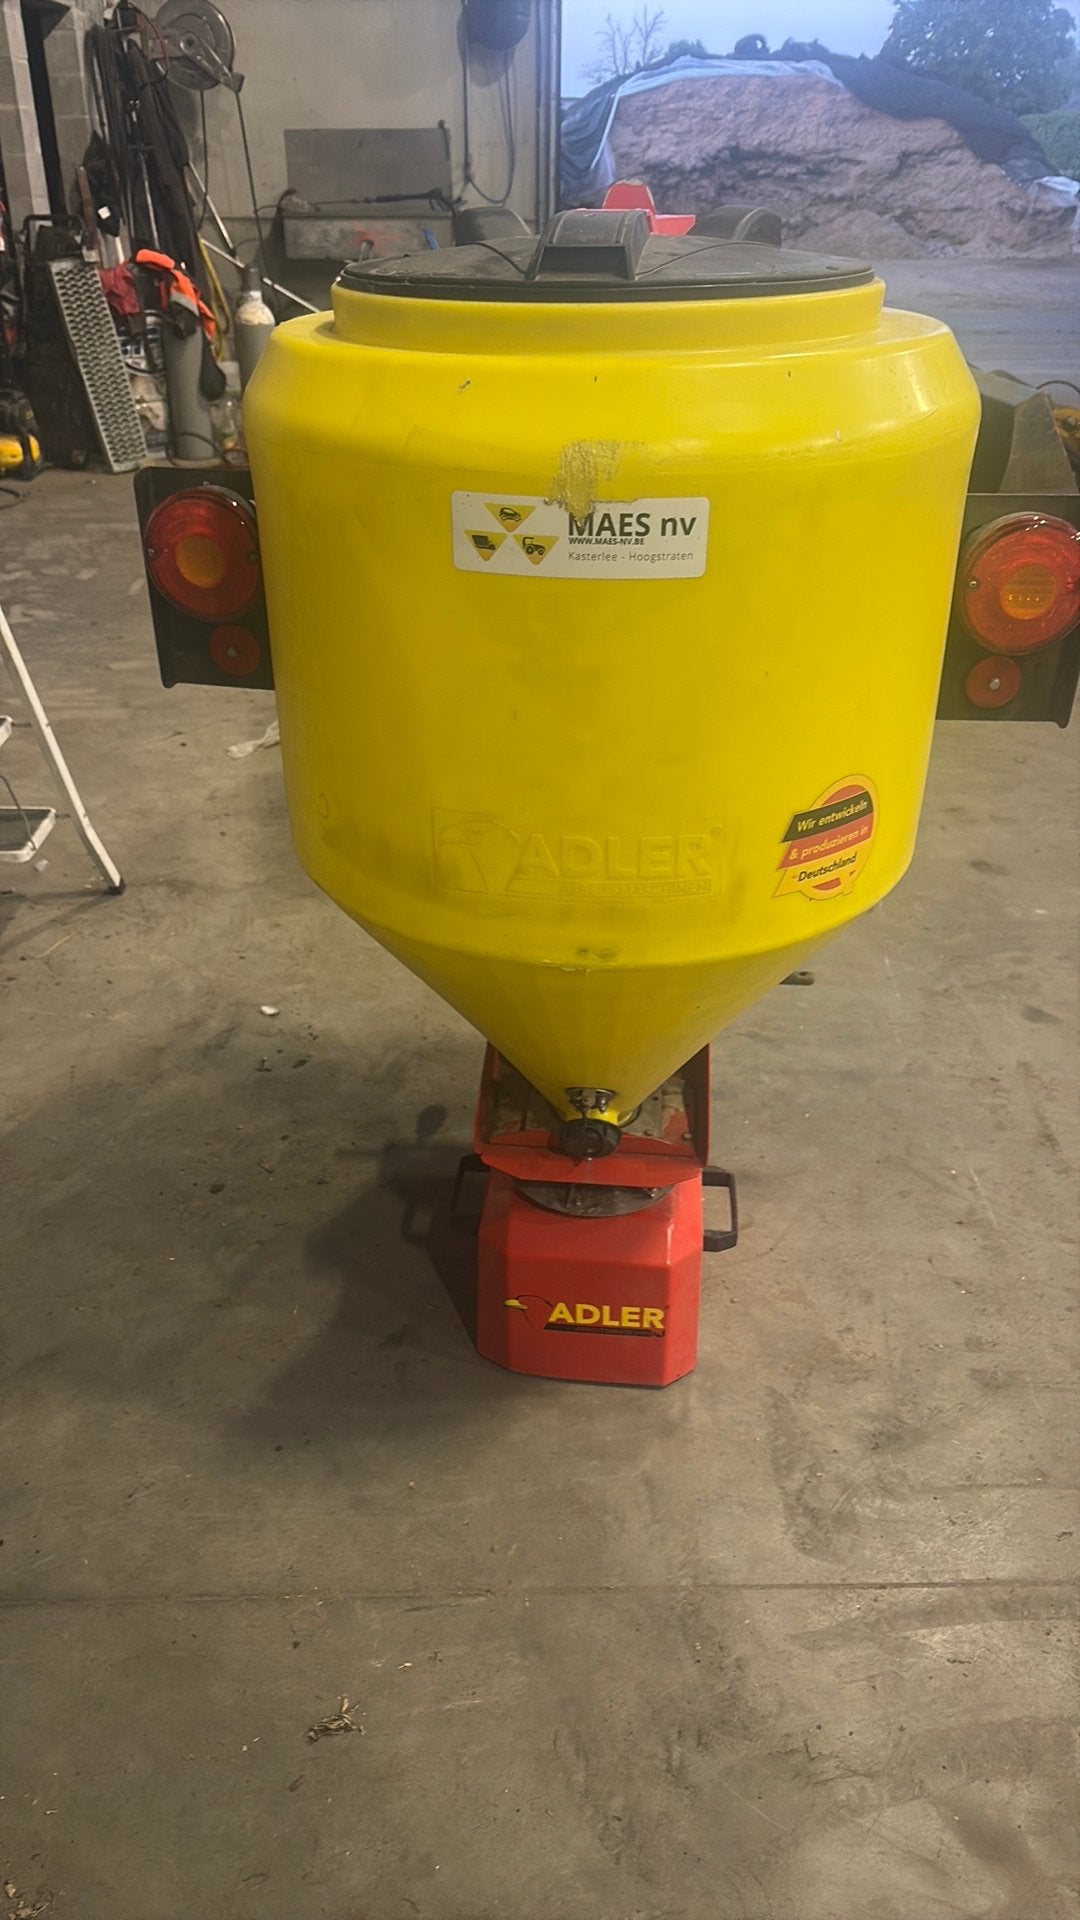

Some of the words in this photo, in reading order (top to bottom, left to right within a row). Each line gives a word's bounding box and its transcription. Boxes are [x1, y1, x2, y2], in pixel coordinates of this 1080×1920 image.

[568, 512, 651, 537] MAES
[660, 516, 697, 537] nv
[568, 537, 645, 546] WWW.MAES-NV.BE
[568, 551, 618, 562] Kasterlee
[628, 551, 694, 564] Hoogstraten
[797, 818, 818, 832] Wir
[818, 799, 868, 826] entwickeln
[789, 848, 799, 860] &
[800, 830, 859, 860] produzieren
[859, 825, 869, 836] in
[798, 851, 858, 882] Deutschland
[548, 1302, 665, 1329] ADLER
